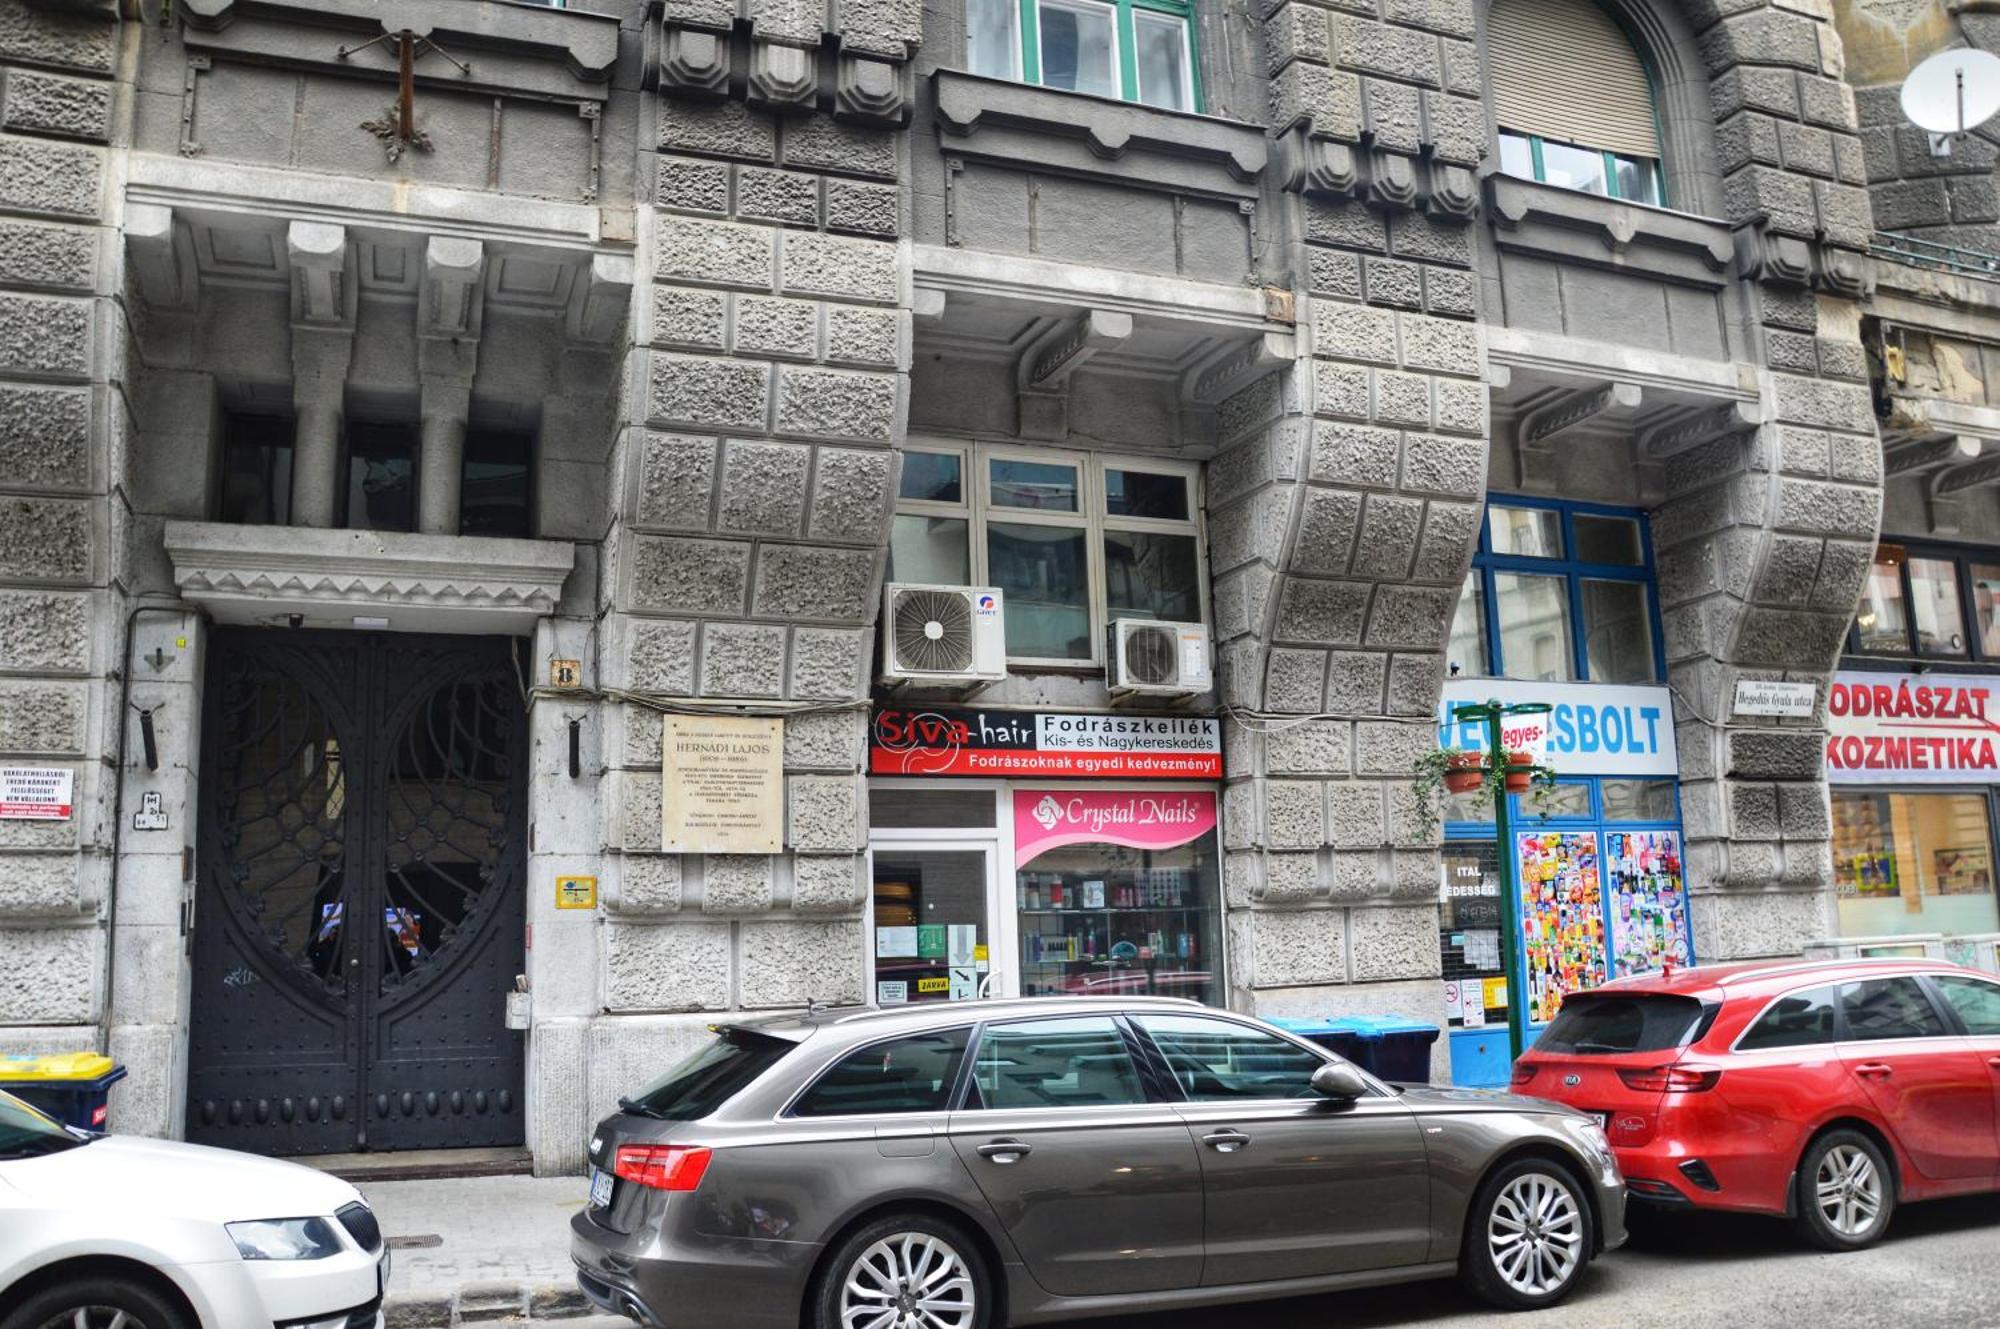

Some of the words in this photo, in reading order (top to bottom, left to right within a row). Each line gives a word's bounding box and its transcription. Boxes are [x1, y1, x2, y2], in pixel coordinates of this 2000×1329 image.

[1794, 696, 1812, 706] utca
[1044, 716, 1213, 735] Fodrászkellék
[1438, 700, 1660, 754] VESBOLT
[732, 743, 771, 754] LAJOS
[1044, 734, 1073, 746] Kis-
[1076, 735, 1094, 747] és
[1098, 735, 1214, 751] Nagykereskedés
[1826, 735, 1998, 770] KOZMETIKA
[969, 754, 1073, 768] Fodrászoknak
[1076, 757, 1124, 772] egyedi
[1127, 758, 1216, 773] kedvezmény!
[1066, 798, 1135, 832] Crystal
[1138, 799, 1197, 824] Nails
[1456, 866, 1482, 877] ITAL
